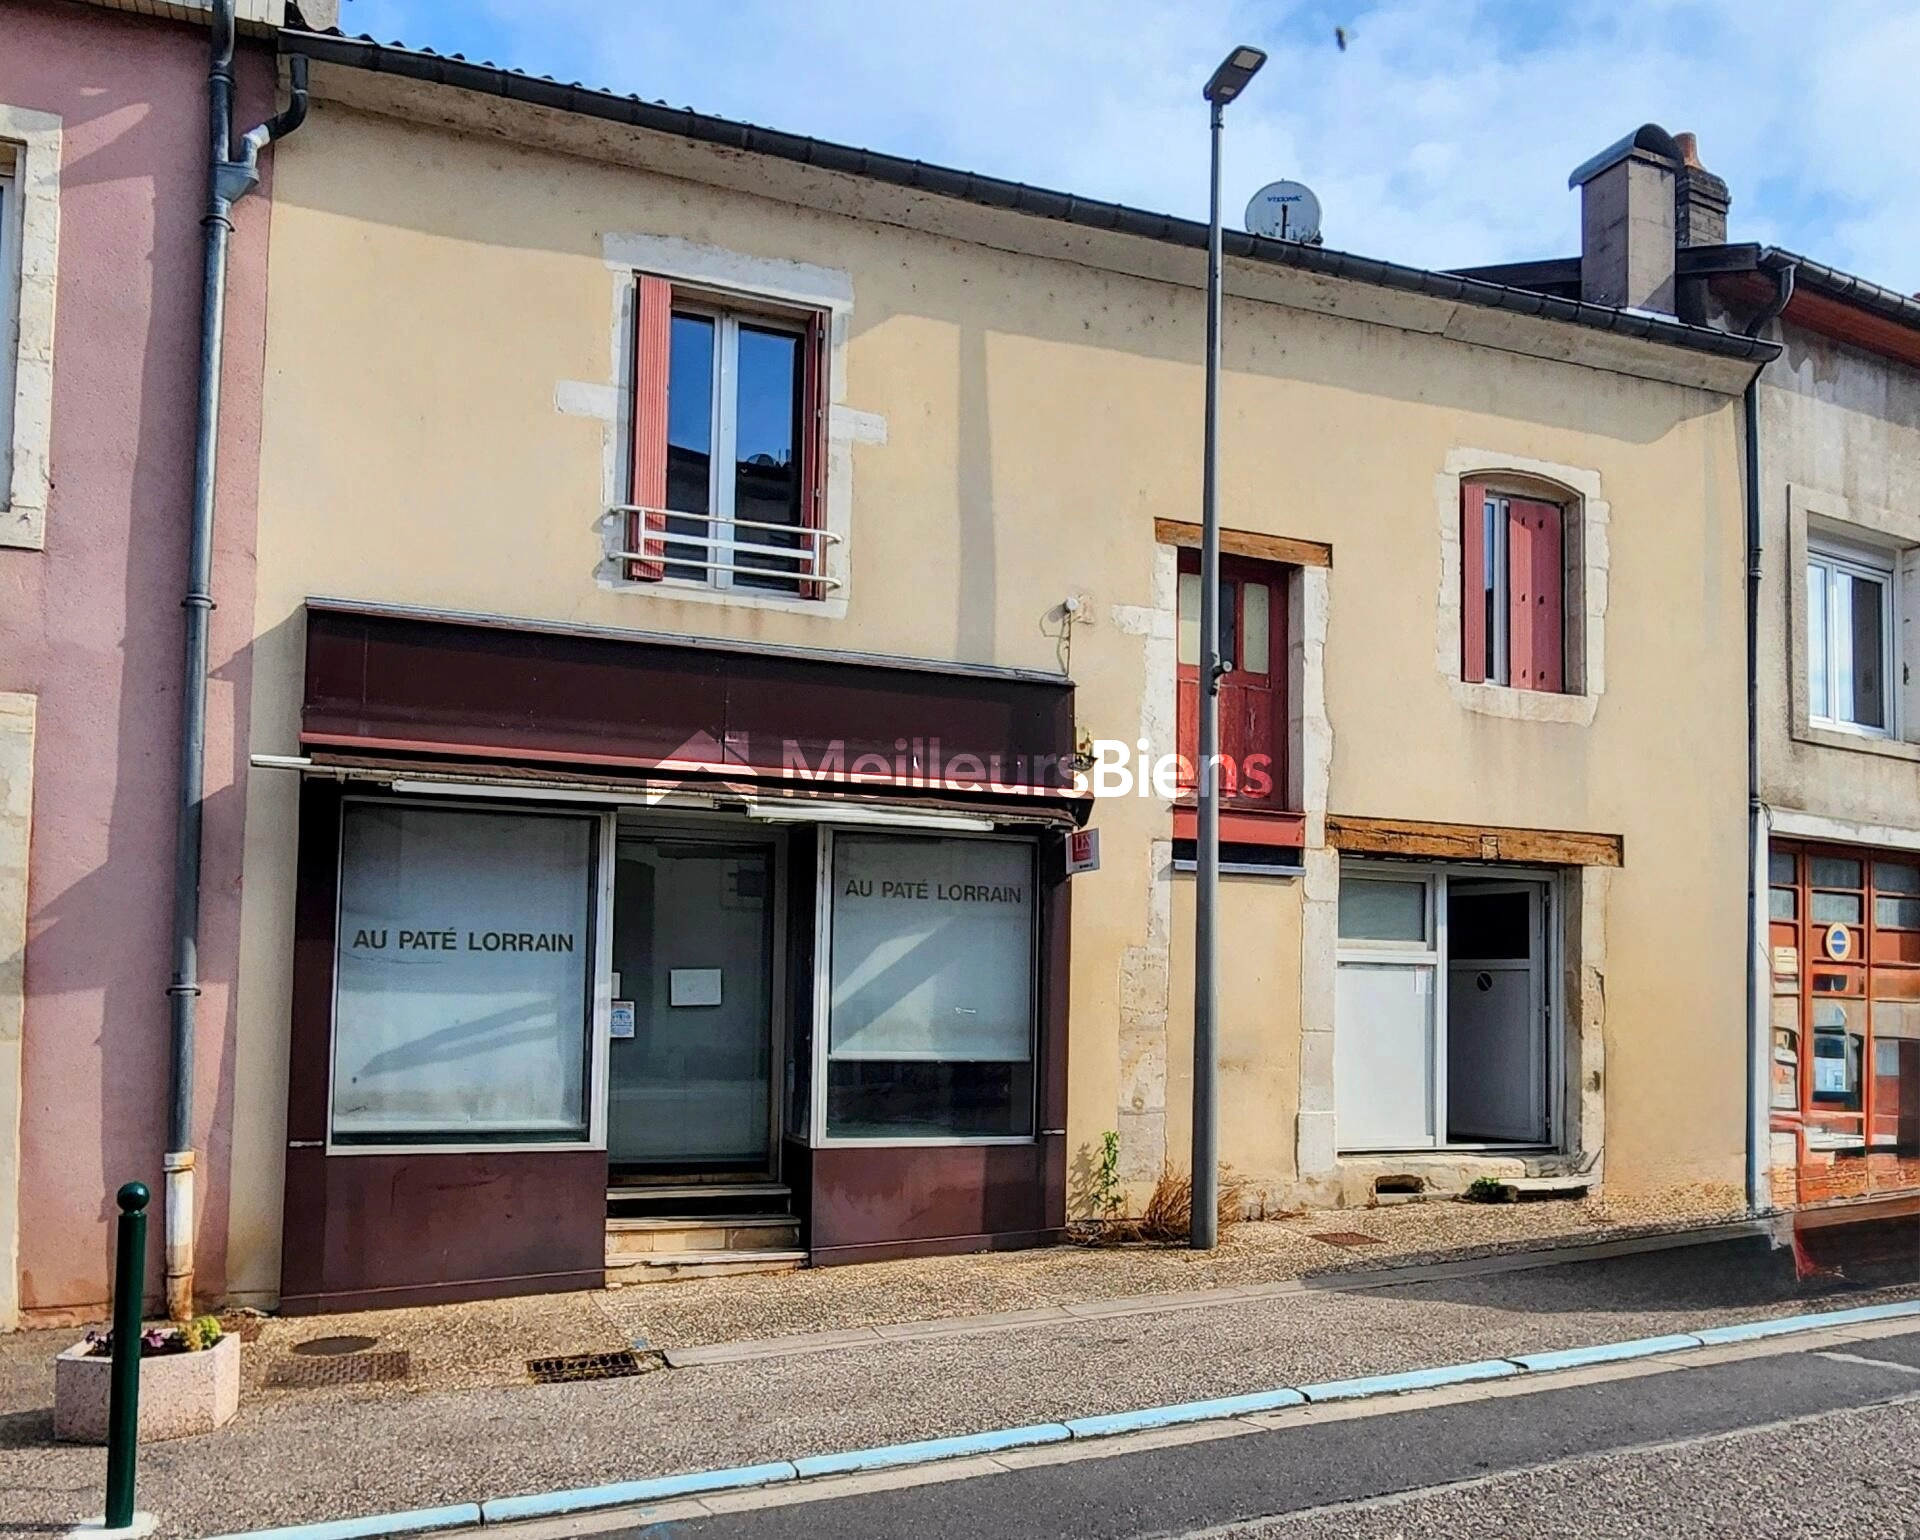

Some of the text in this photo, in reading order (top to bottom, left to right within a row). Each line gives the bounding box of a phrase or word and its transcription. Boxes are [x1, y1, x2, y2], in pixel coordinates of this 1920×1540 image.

[844, 879, 1021, 903] AU PATÉ LORRAIN
[352, 927, 574, 953] AU PATÉ LORRAIN
